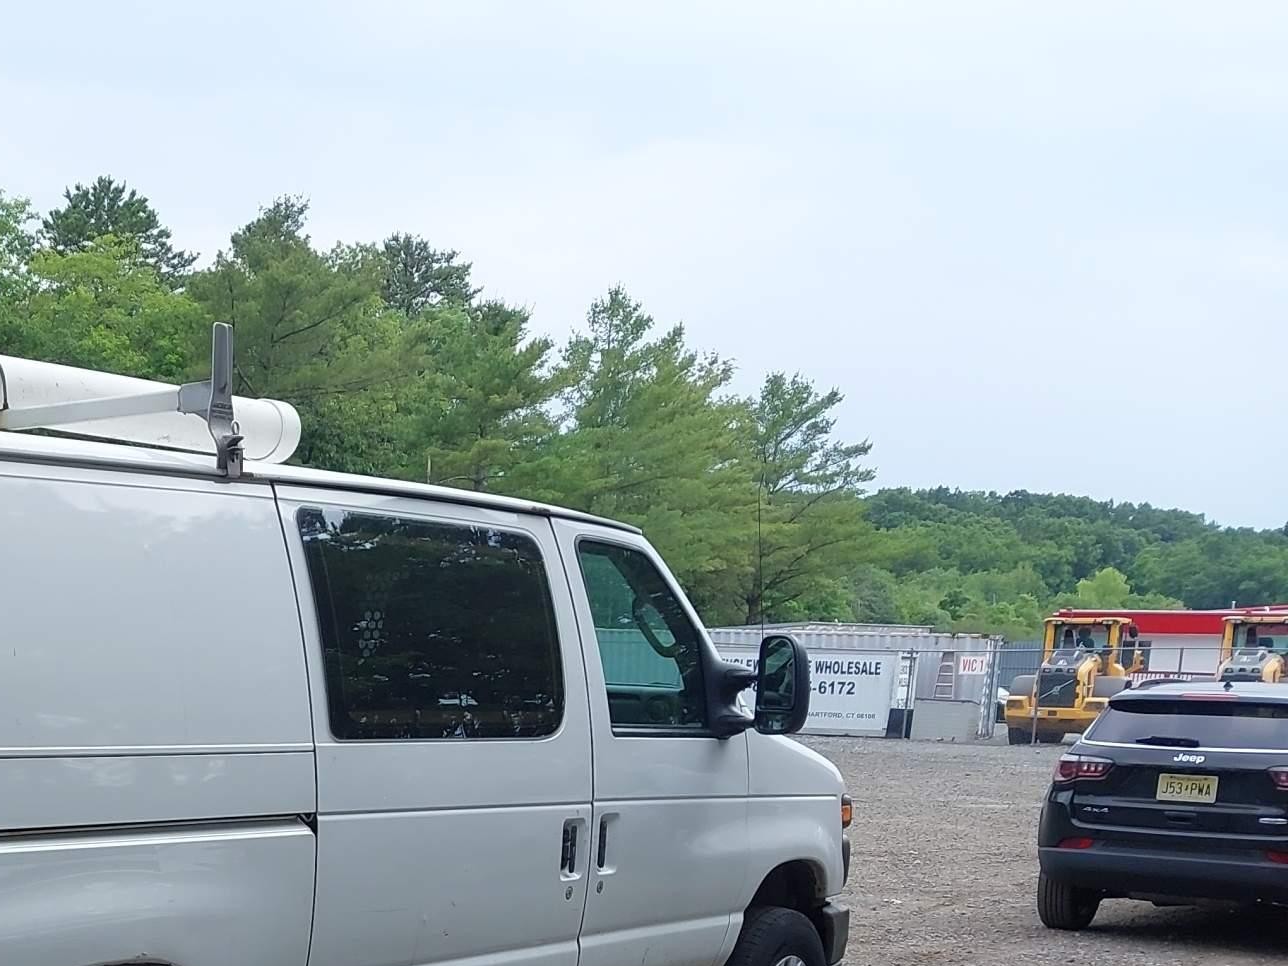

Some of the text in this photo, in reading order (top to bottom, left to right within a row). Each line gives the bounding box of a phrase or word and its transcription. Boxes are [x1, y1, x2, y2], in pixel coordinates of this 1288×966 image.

[815, 660, 881, 675] WHOLESALE
[962, 659, 984, 672] VIC 1
[1173, 753, 1205, 764] Jeep
